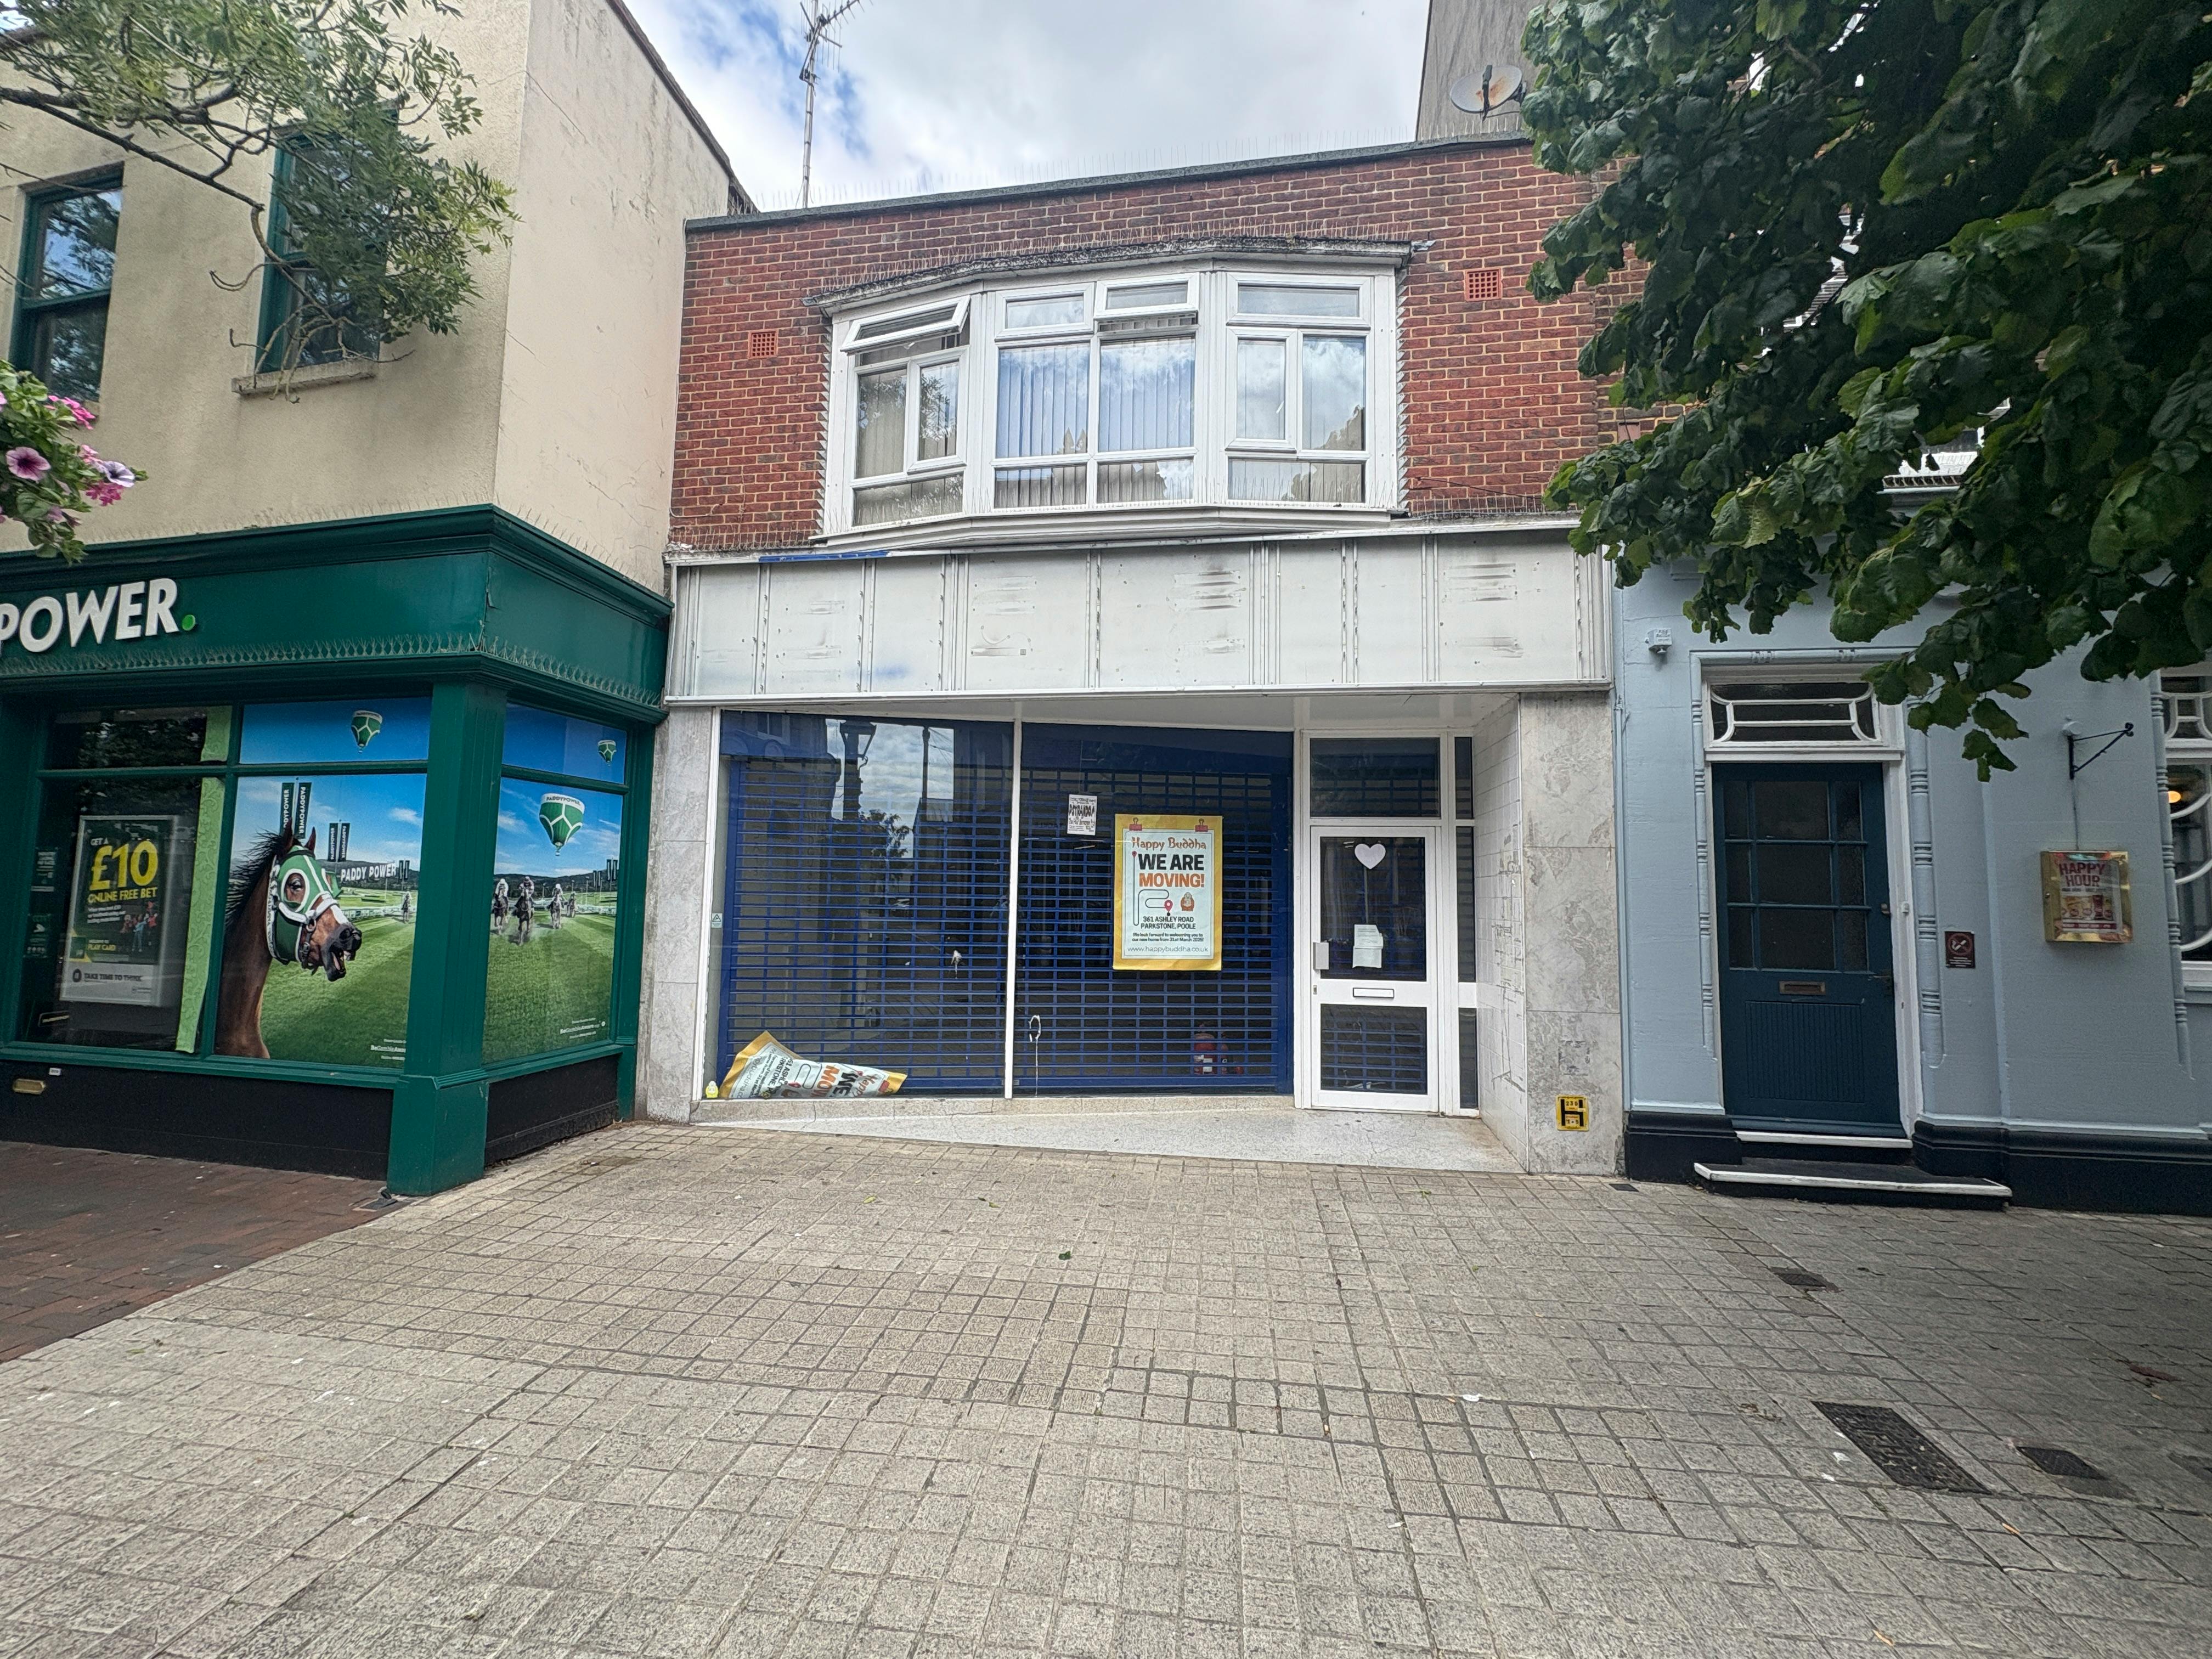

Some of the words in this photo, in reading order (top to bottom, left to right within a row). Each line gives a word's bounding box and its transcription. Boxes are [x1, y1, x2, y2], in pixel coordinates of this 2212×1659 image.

[1132, 837, 1165, 851] Happy
[1167, 837, 1206, 849] Buddha
[89, 840, 158, 890] £10
[1138, 854, 1166, 870] WE
[1170, 854, 1204, 870] ARE
[2059, 862, 2105, 875] HAPPY
[341, 866, 367, 881] PADDY
[369, 864, 396, 878] POWER
[1139, 873, 1204, 887] MOVING!
[2066, 874, 2100, 887] HOUR
[88, 891, 117, 904] ONLINE
[120, 889, 138, 900] FREE
[140, 887, 157, 898] BET
[833, 1072, 859, 1096] WE
[1561, 1099, 1584, 1126] H
